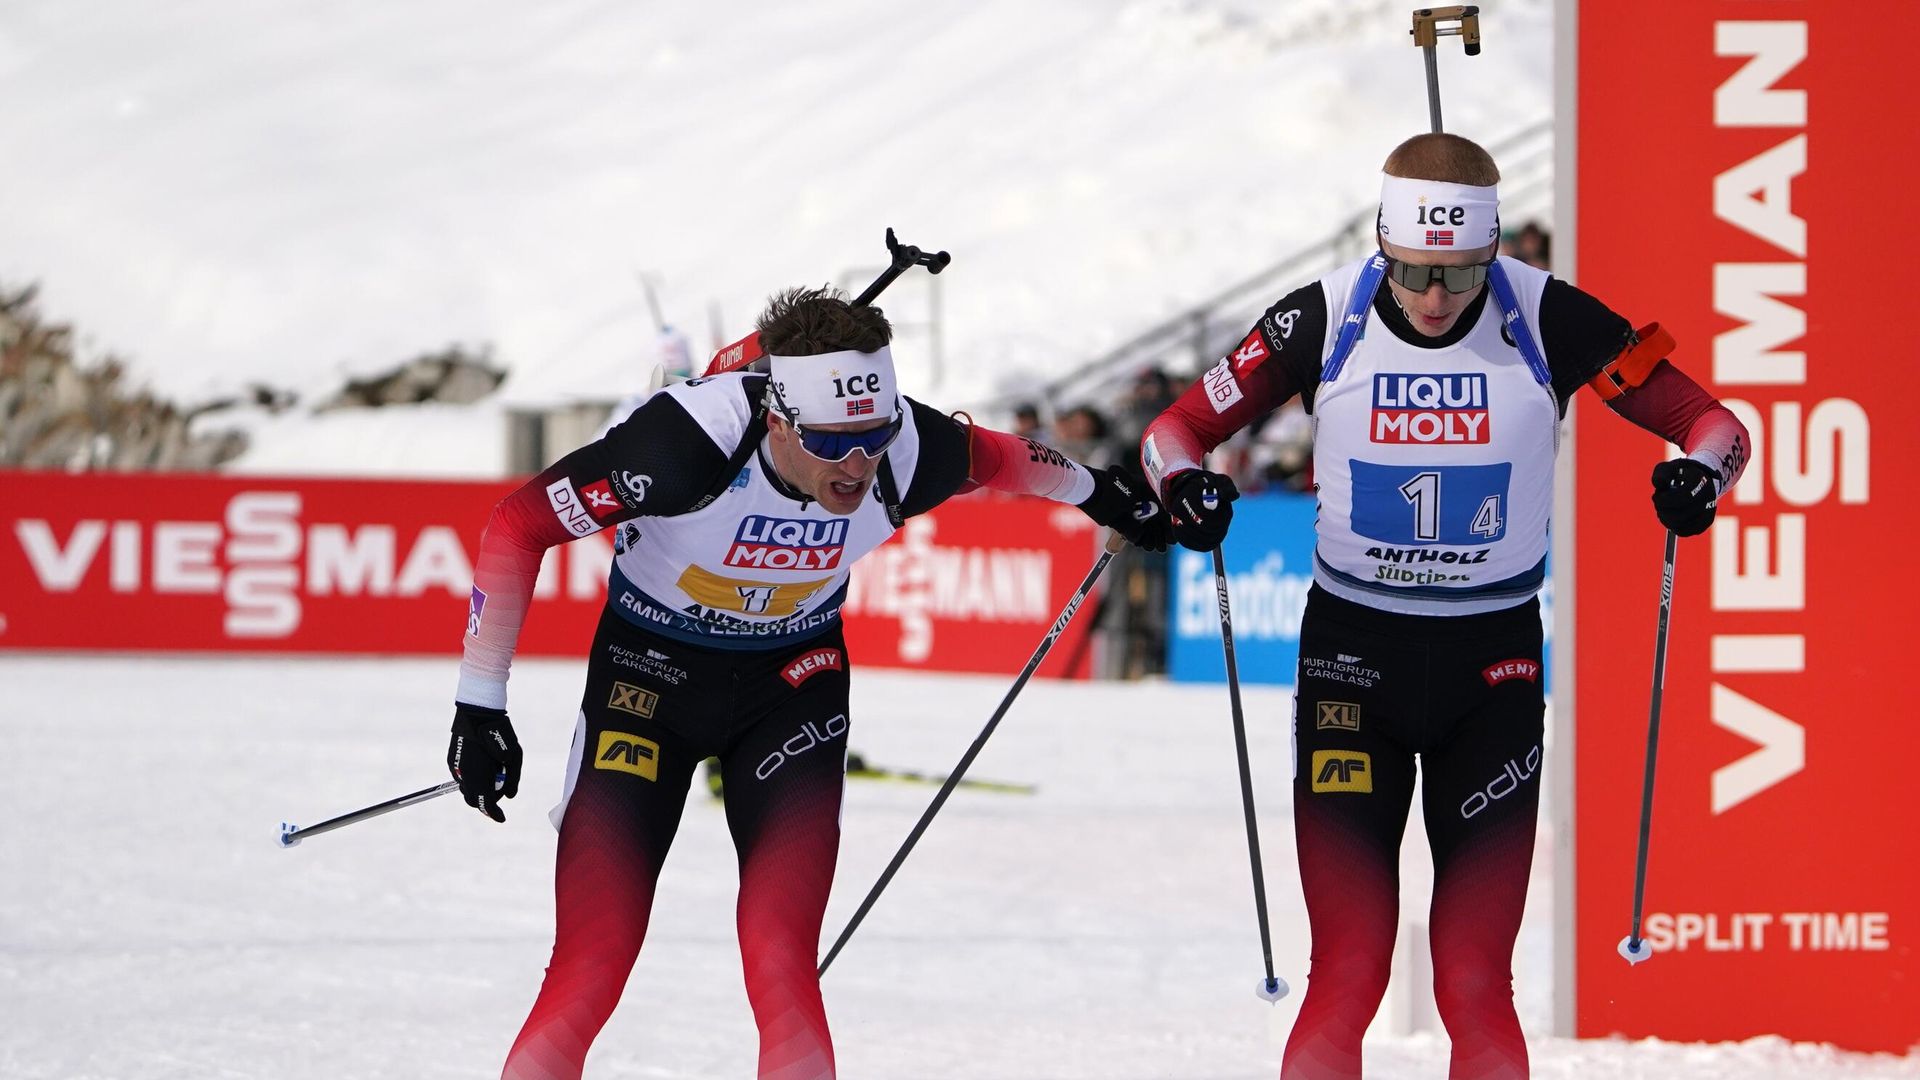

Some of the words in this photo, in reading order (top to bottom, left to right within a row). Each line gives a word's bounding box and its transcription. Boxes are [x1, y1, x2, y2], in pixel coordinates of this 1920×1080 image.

[1417, 205, 1465, 226] ice
[1264, 317, 1283, 351] odlo
[833, 372, 880, 398] ice
[1378, 376, 1483, 409] LIQUI
[1376, 412, 1487, 442] MOLY
[611, 470, 637, 509] odlo
[553, 487, 592, 534] DNB
[1399, 472, 1441, 541] 1
[1470, 494, 1503, 538] 4
[741, 518, 844, 546] LIQUI
[730, 545, 840, 569] MOLY
[1365, 546, 1491, 564] ANTHOLZ
[735, 586, 780, 612] 1
[1216, 574, 1231, 625] SWIX
[1660, 562, 1673, 610] SWIX
[619, 590, 674, 625] BMW
[1047, 590, 1085, 643] SWIX
[608, 643, 688, 680] HURTIGRUTA
[612, 655, 680, 686] CARGLASS
[788, 652, 836, 680] MENY
[1303, 657, 1381, 680] HURTIGRUTA
[1490, 663, 1537, 681] MENY
[1306, 668, 1373, 688] CARGLASS
[611, 685, 651, 715] XL
[1319, 704, 1357, 727] XL
[600, 740, 653, 766] AF
[756, 713, 847, 780] odlo
[1316, 758, 1366, 784] AF
[1460, 745, 1540, 819] odlo
[1645, 912, 1773, 951] SPLIT
[1780, 911, 1889, 951] TIME
